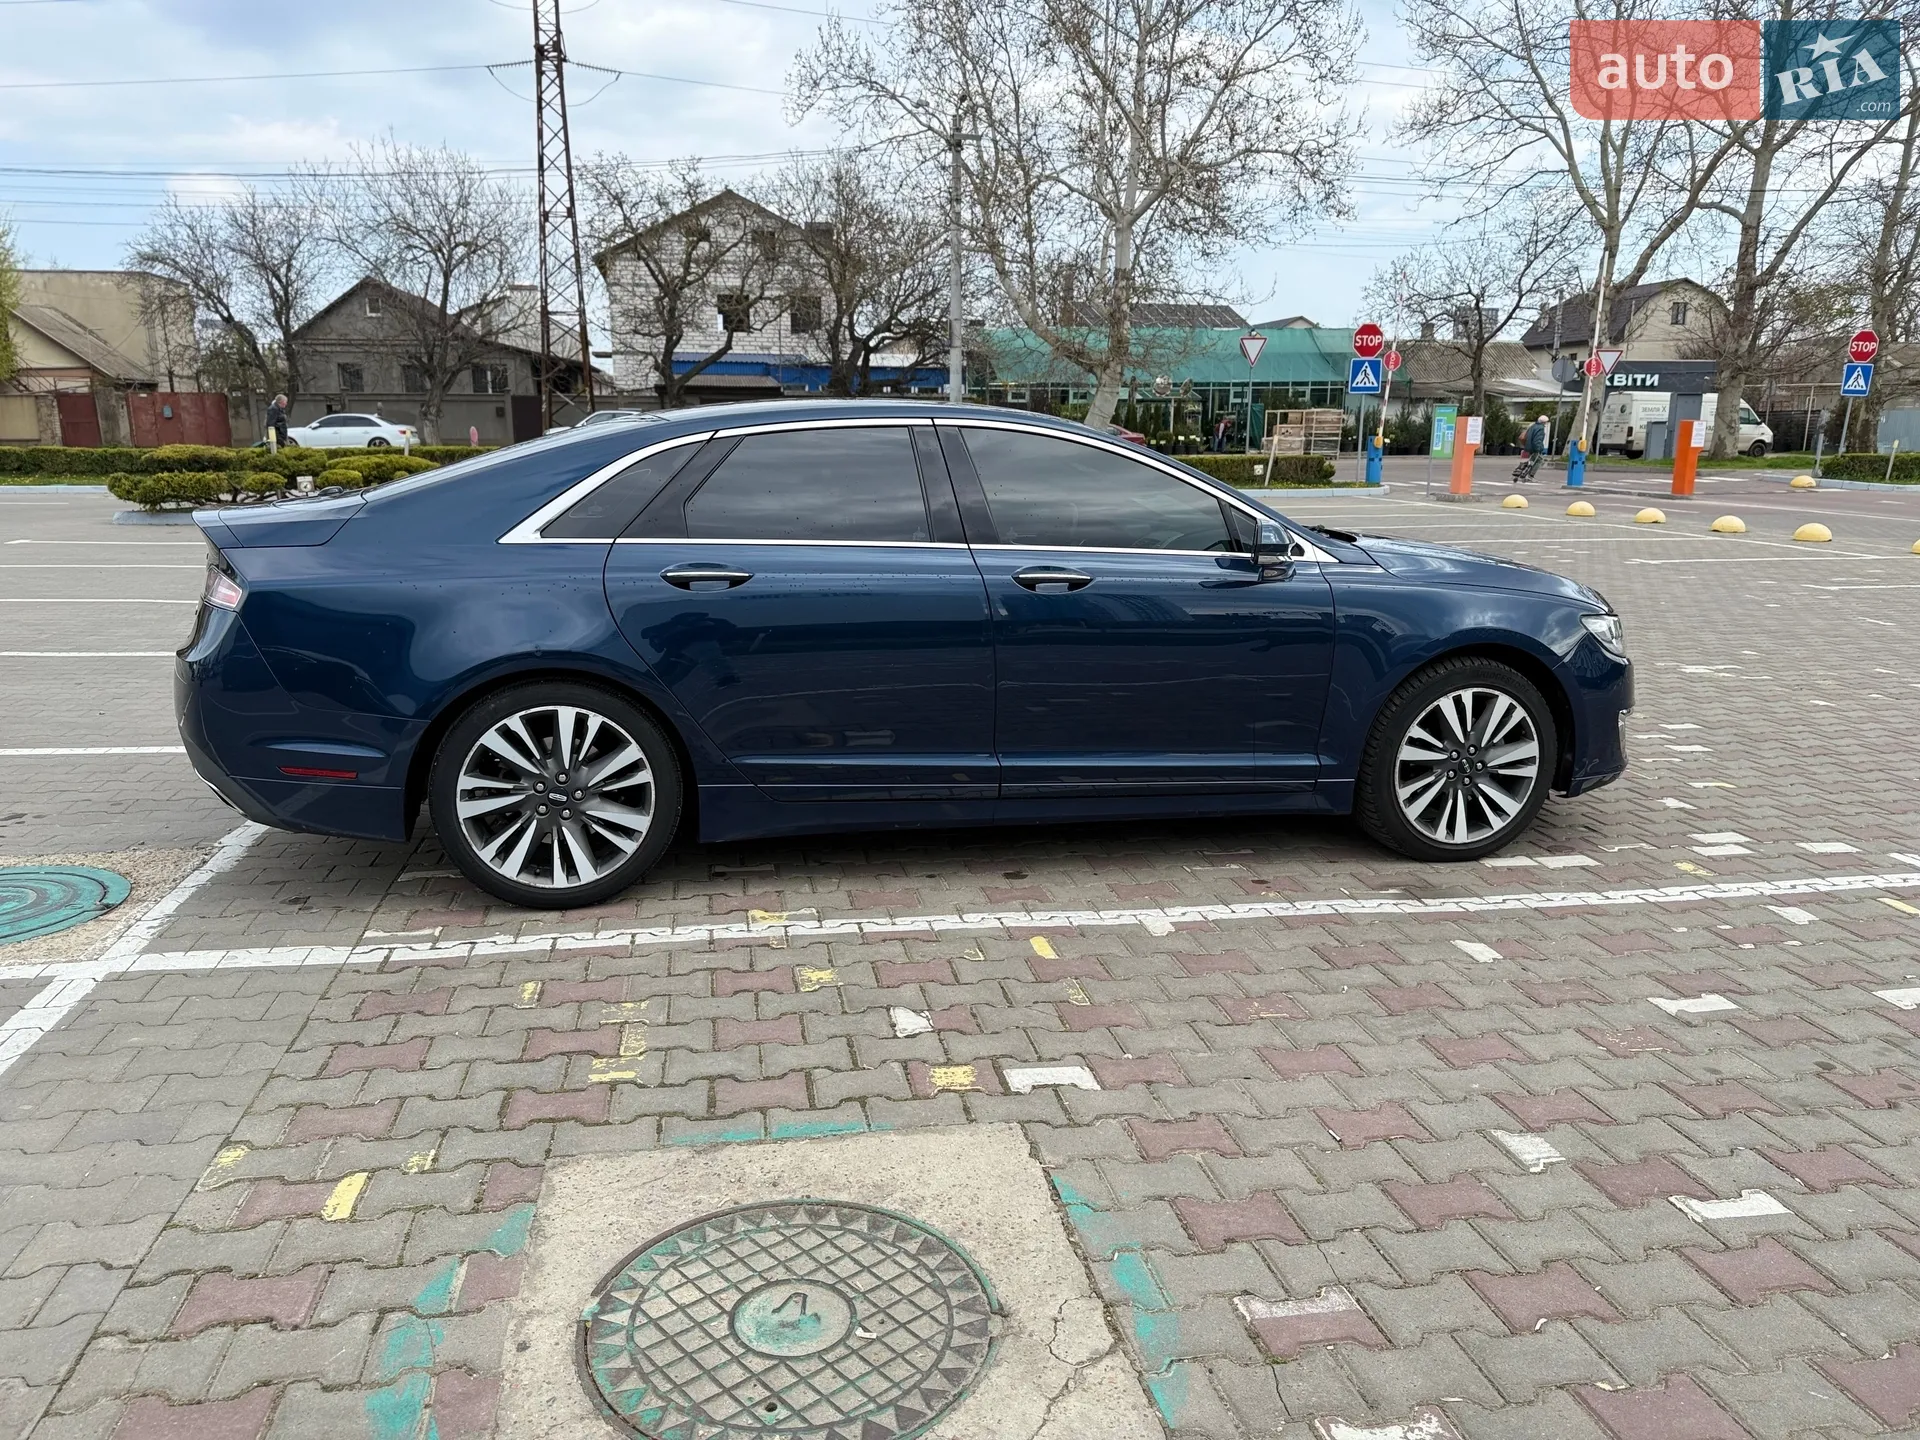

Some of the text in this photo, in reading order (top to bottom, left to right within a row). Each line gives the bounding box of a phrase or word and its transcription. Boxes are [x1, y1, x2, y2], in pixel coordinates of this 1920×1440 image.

[1355, 335, 1382, 346] STOP
[1851, 341, 1877, 352] STOP
[1388, 351, 1396, 369] STOP
